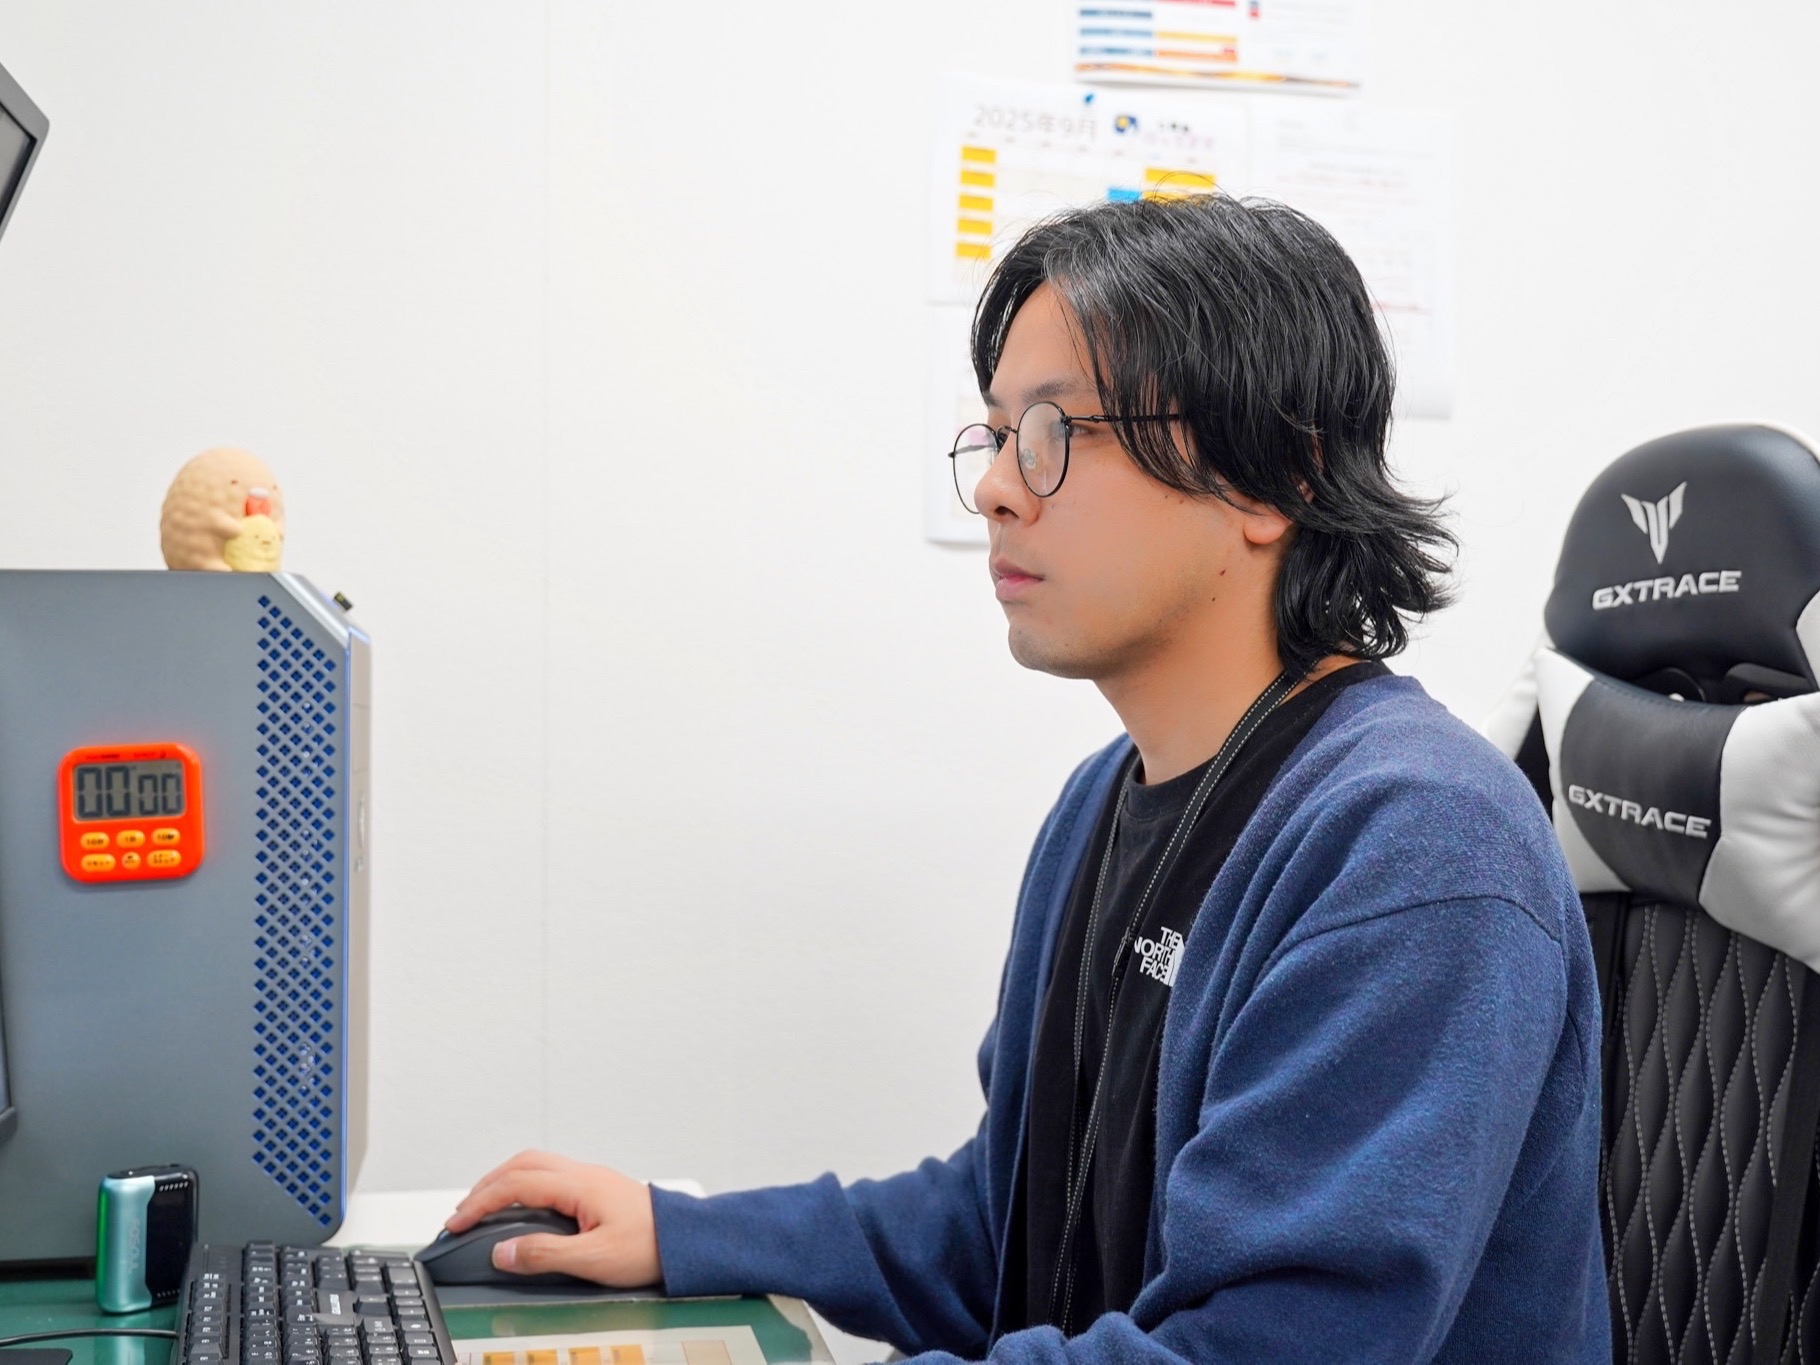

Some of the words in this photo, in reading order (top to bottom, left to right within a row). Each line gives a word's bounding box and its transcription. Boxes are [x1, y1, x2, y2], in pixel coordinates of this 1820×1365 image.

[1592, 570, 1742, 611] GXTRACE
[1568, 784, 1712, 839] GXTRACE
[1160, 926, 1182, 951] THE
[1139, 956, 1170, 984] FACE
